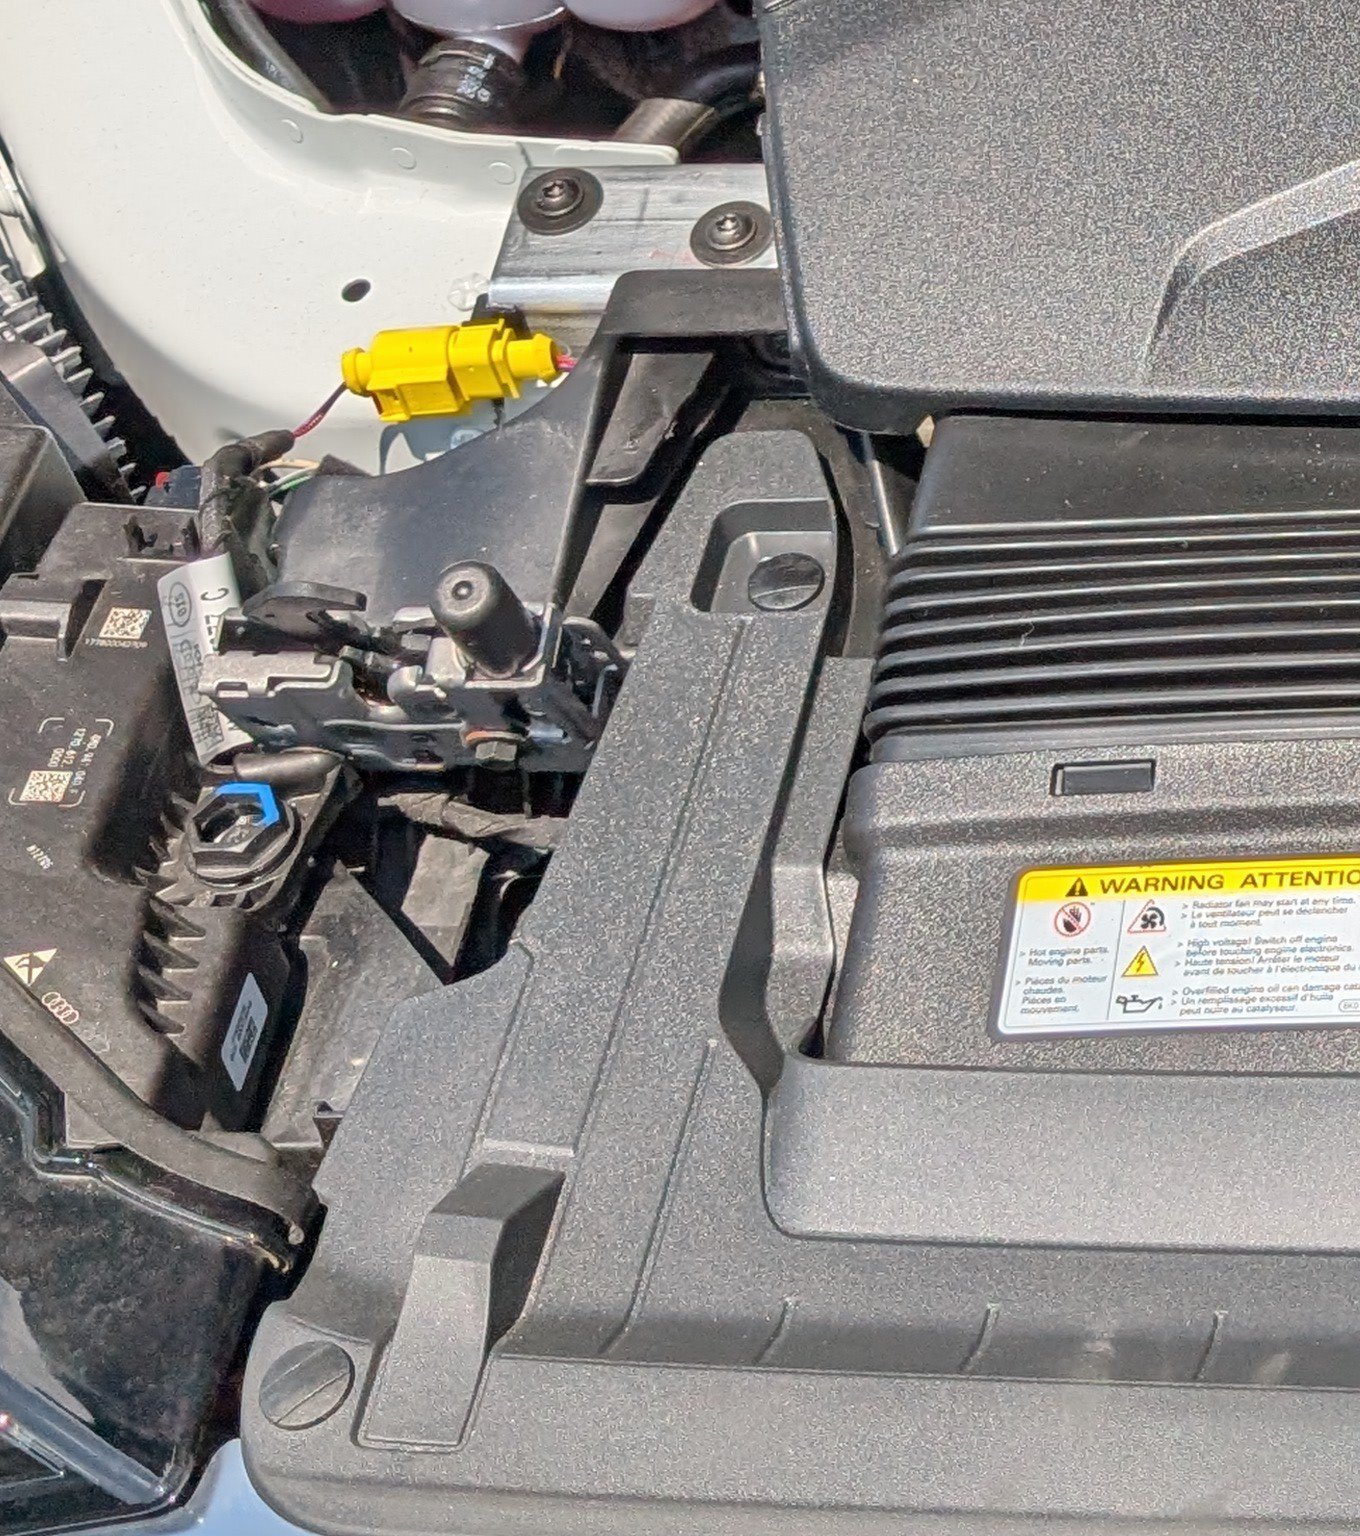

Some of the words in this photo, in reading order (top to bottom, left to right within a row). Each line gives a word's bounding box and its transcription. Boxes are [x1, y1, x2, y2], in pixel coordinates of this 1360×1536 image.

[1099, 874, 1225, 894] WARNING
[1192, 900, 1232, 909] Radiator
[1235, 899, 1250, 907] fan
[1254, 900, 1273, 908] may
[1301, 897, 1309, 905] at
[1332, 896, 1356, 905] time.
[1191, 911, 1202, 919] Le
[1206, 909, 1256, 918] ventilateur
[1258, 908, 1279, 918] peut
[1198, 920, 1218, 928] tout
[1220, 918, 1262, 927] moment.
[1187, 938, 1209, 948] High
[1213, 937, 1252, 947] voltage!
[1254, 935, 1287, 944] Switch
[1289, 935, 1303, 943] off
[1305, 934, 1338, 944] engine
[1029, 947, 1047, 957] Hot
[1049, 946, 1081, 958] engine
[1083, 946, 1110, 958] parts.
[1186, 948, 1217, 957] before
[1220, 946, 1261, 957] touching
[1264, 946, 1297, 956] engine
[1300, 944, 1354, 953] electronics.
[1028, 956, 1065, 967] Moving
[1066, 954, 1093, 966] parts.
[1184, 958, 1213, 966] Haute
[1216, 956, 1255, 965] tension!
[1304, 955, 1341, 963] moteur
[1183, 968, 1211, 976] avant
[1212, 967, 1225, 975] de
[1226, 966, 1264, 975] toucher
[1343, 963, 1356, 971] du
[1057, 975, 1070, 984] du
[1072, 974, 1108, 984] moteur
[1023, 985, 1065, 995] chaudes.
[1182, 985, 1230, 996] Overfilled
[1232, 984, 1265, 995] engine
[1267, 983, 1279, 992] oil
[1282, 984, 1300, 992] can
[1302, 983, 1341, 993] damage
[1054, 996, 1067, 1004] en
[1181, 997, 1196, 1005] Un
[1197, 995, 1258, 1006] remplissage
[1259, 994, 1299, 1003] excessif
[1020, 1004, 1080, 1015] mouvement.
[1179, 1006, 1201, 1016] peut
[1204, 1005, 1230, 1015] nuire
[1231, 1006, 1244, 1014] au
[1246, 1004, 1298, 1015] catalyseur.
